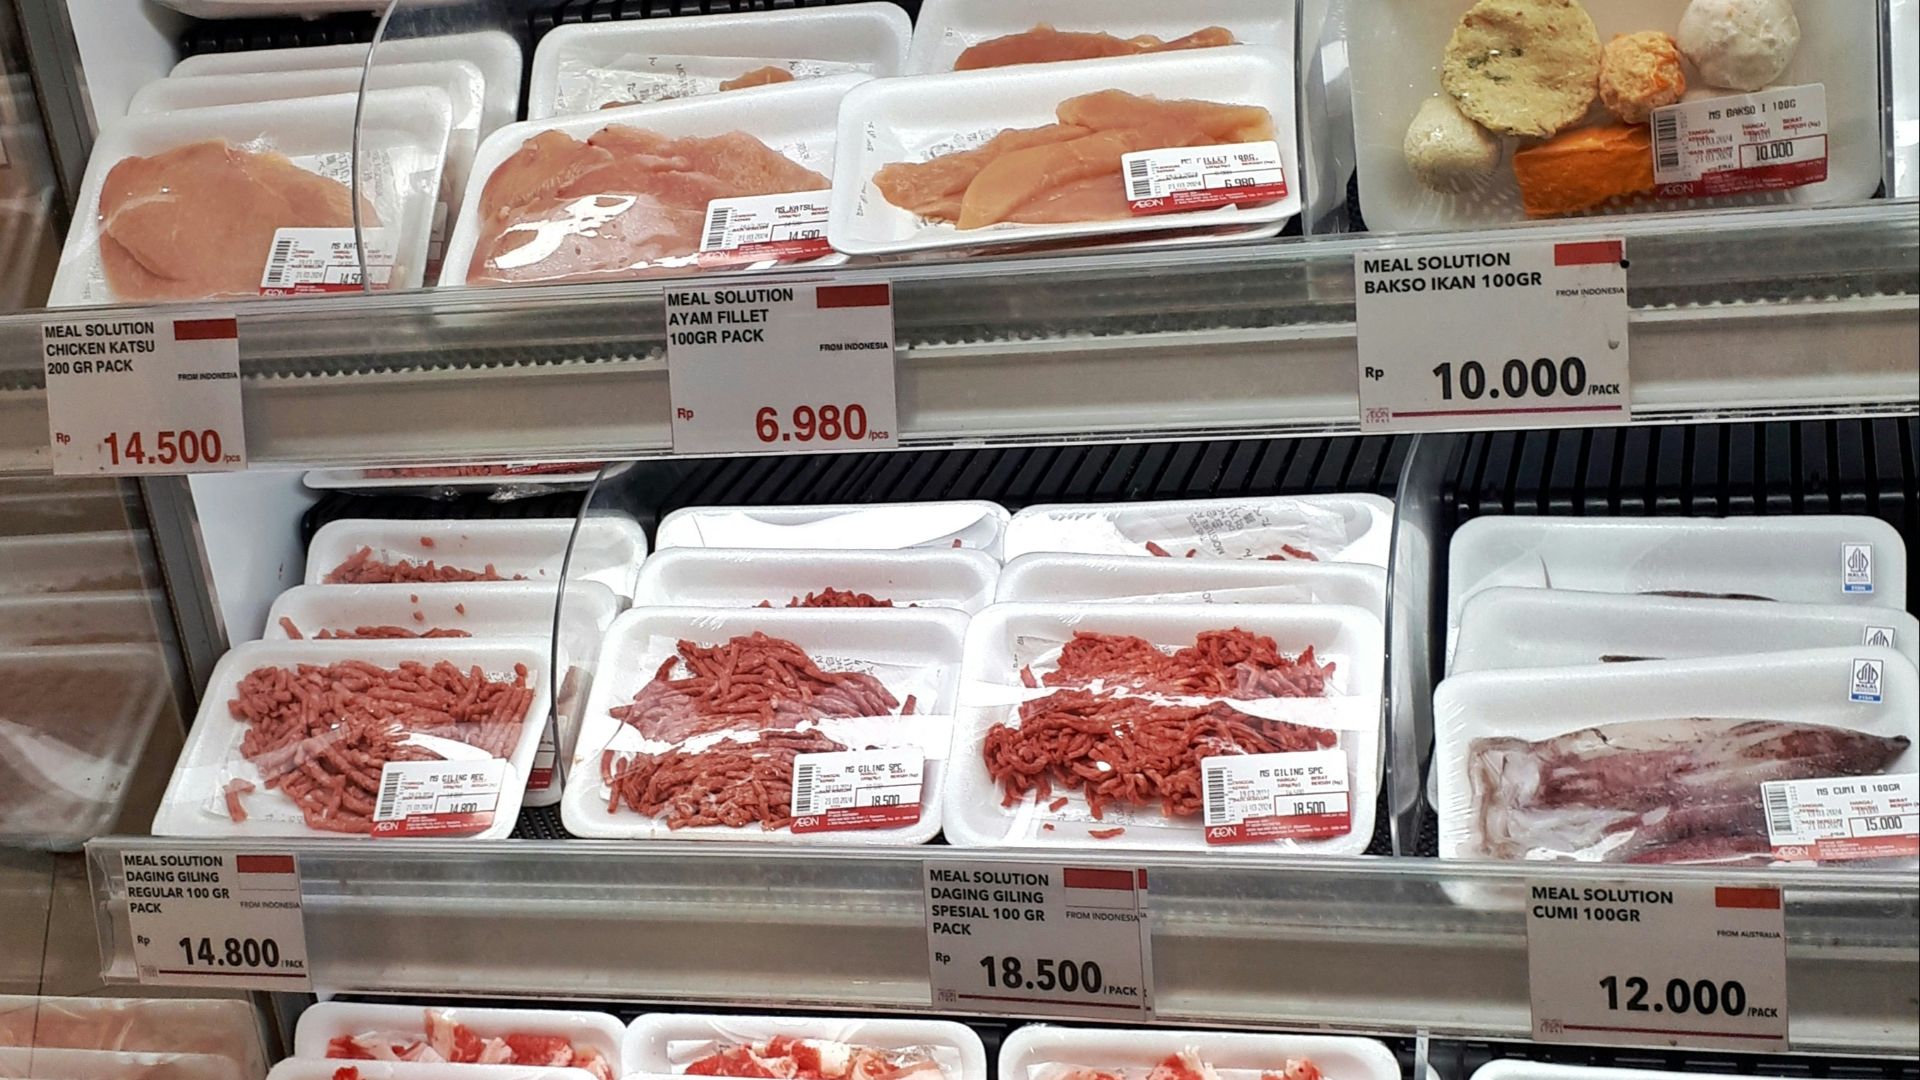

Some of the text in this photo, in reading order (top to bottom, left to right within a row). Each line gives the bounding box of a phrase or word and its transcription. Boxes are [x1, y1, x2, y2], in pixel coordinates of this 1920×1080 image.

[1709, 110, 1721, 120] MS
[1756, 142, 1793, 161] 10.000
[1660, 185, 1693, 195] AEON
[1133, 199, 1163, 208] AEON
[1364, 253, 1510, 273] MEAL SOLUTION
[1365, 272, 1542, 294] BAKSO IKAN 100GR
[668, 288, 793, 306] MEAL SOLUTION
[1556, 287, 1624, 297] FROM INDONESIA
[669, 310, 768, 325] AYAM FILLET
[45, 322, 154, 337] MEAL SOLUTION
[670, 329, 764, 345] 100GR PACK
[47, 341, 155, 356] CHICKEN KATSU
[845, 342, 888, 350] INDONESIA
[48, 360, 133, 374] 200 GR PACK
[200, 372, 238, 380] INDONESIA
[1365, 357, 1620, 400] Rp 10.000 /PACK
[677, 404, 888, 442] Rp 6.980 /pcs
[56, 429, 240, 465] Rp 14.500 /pcs
[859, 764, 884, 772] GILING
[442, 774, 467, 782] GILING
[374, 822, 399, 831] AEON
[793, 817, 819, 827] AEON
[1866, 816, 1902, 830] 15.000
[1209, 827, 1236, 837] AEON
[124, 855, 223, 866] MEAL SOLUTION
[127, 872, 219, 882] DAGING GILING
[930, 869, 1049, 886] MEAL SOLUTION
[128, 888, 229, 899] REGULAR 100 GR
[931, 888, 1044, 903] DAGING GILING
[1532, 887, 1673, 904] MEAL SOLUTION
[130, 903, 161, 913] PACK
[932, 905, 1045, 921] SPESIAL 100 GR
[1533, 906, 1640, 921] CUMI 100GR
[1066, 911, 1090, 920] FROM
[1093, 913, 1139, 922] INDONESIA
[933, 923, 971, 935] PACK
[137, 936, 150, 946] Rp
[179, 937, 279, 967] 14.800
[935, 953, 950, 964] Rp
[980, 956, 1101, 993] 18.500
[1600, 976, 1778, 1017] 12.000 /PACK
